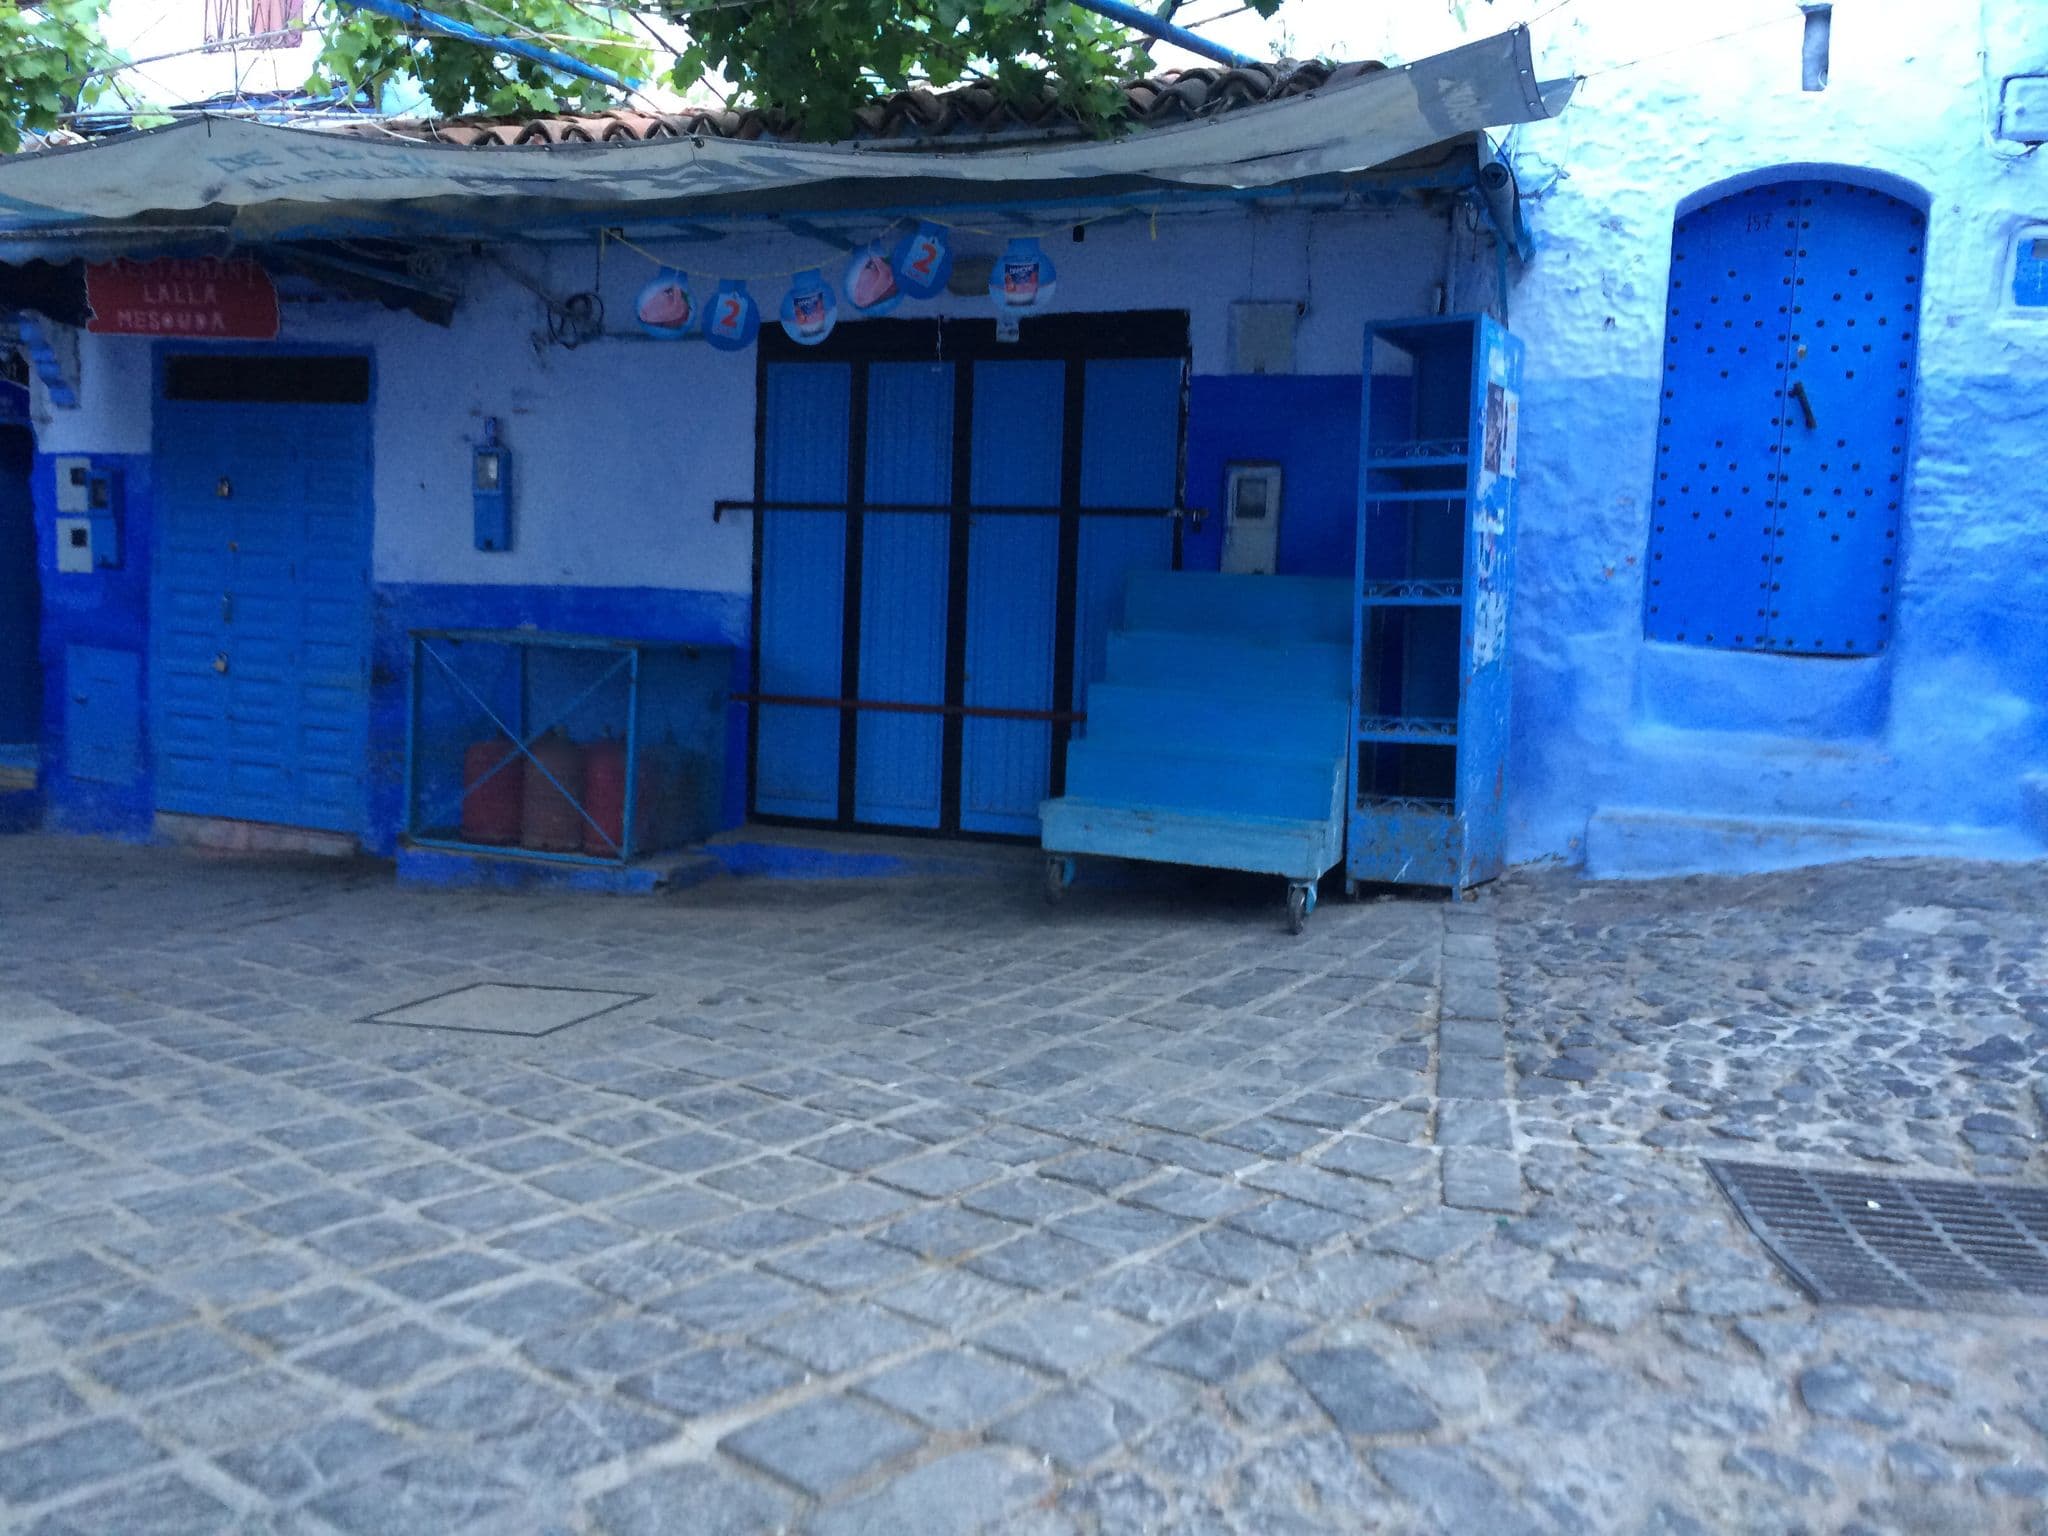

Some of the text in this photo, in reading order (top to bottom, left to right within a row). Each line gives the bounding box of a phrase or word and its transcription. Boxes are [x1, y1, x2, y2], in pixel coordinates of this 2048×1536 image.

[912, 242, 937, 275] 2
[143, 283, 217, 304] LALLA
[117, 309, 226, 331] MESOUDA
[720, 299, 740, 329] 2
